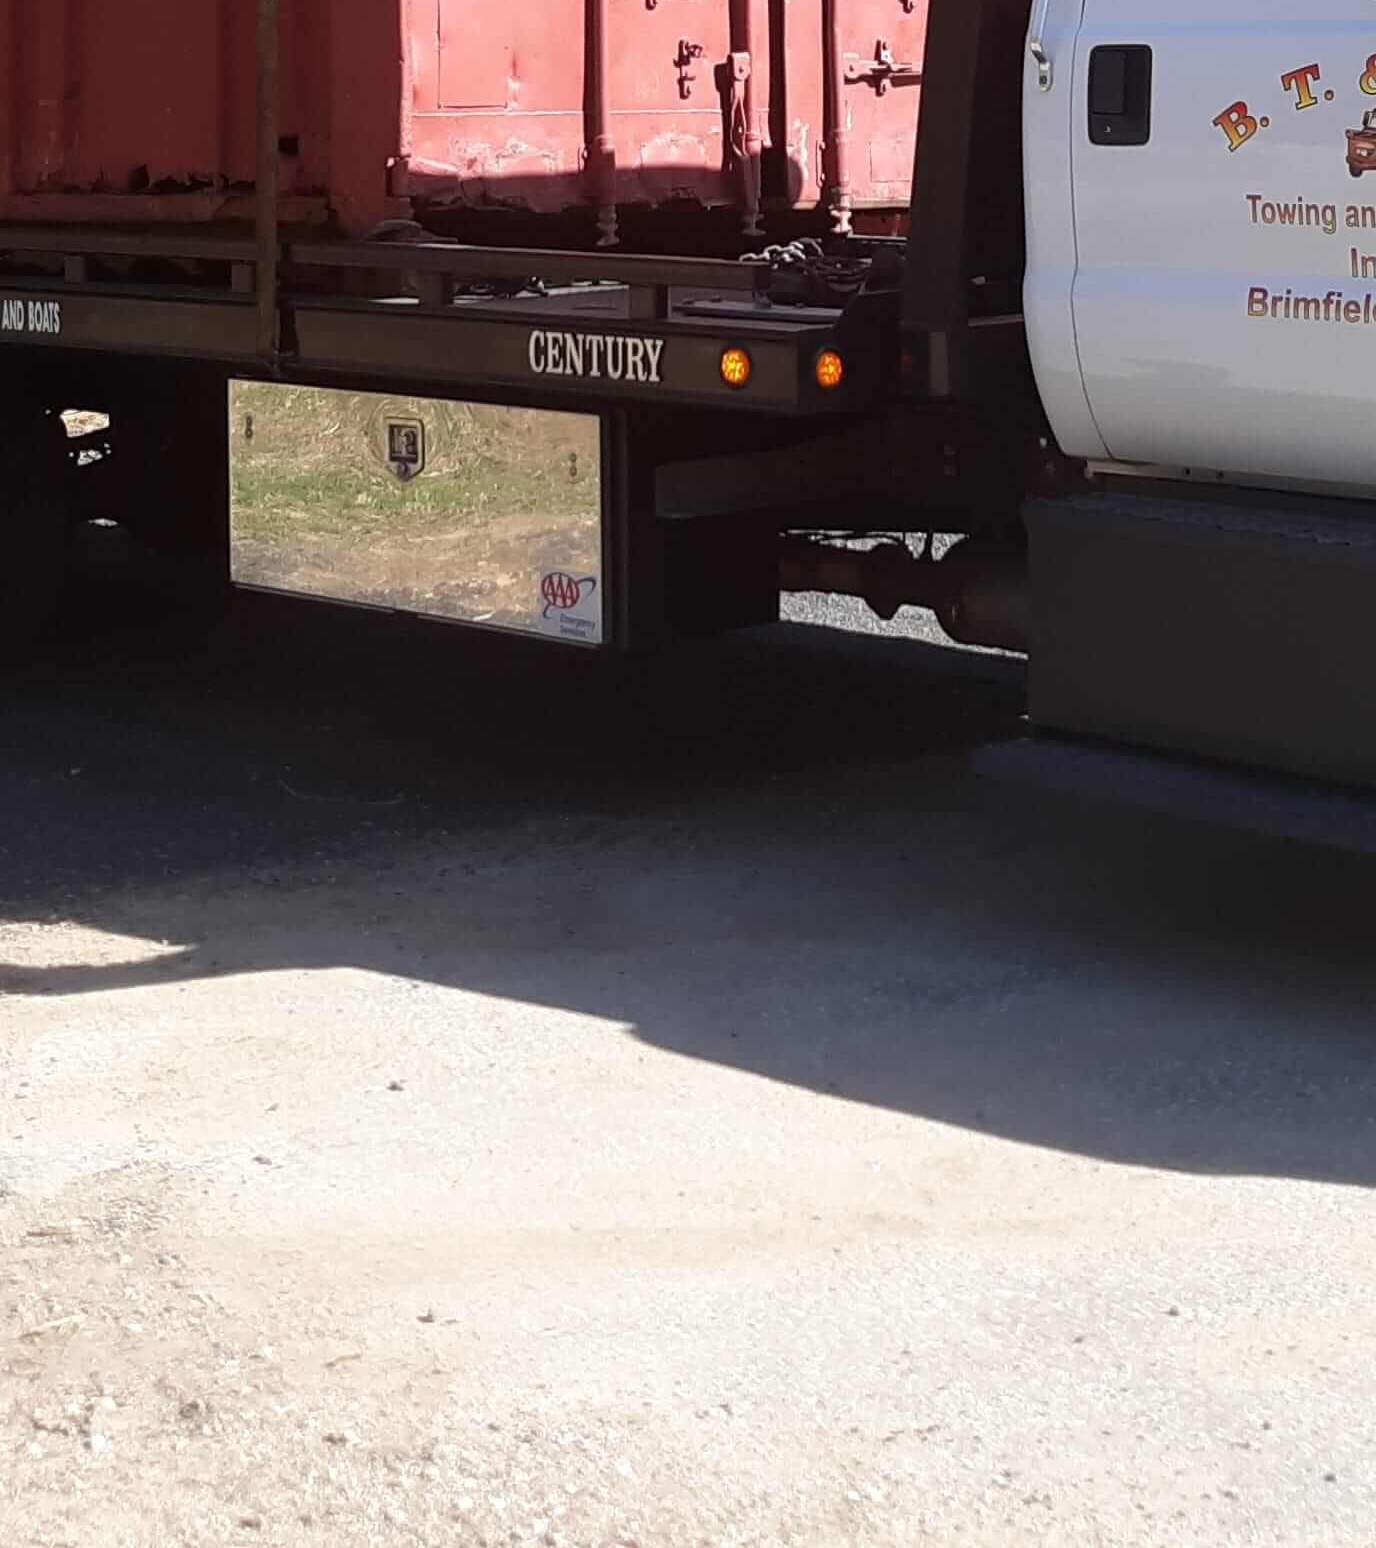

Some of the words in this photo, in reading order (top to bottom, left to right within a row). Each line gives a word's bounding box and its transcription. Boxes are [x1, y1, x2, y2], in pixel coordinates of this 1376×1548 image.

[1213, 101, 1269, 152] B.
[1281, 63, 1334, 110] T.
[1246, 194, 1337, 234] Towing
[2, 300, 25, 331] AND
[28, 302, 61, 333] BOATS
[529, 330, 663, 383] CENTURY
[545, 574, 575, 606] AAA
